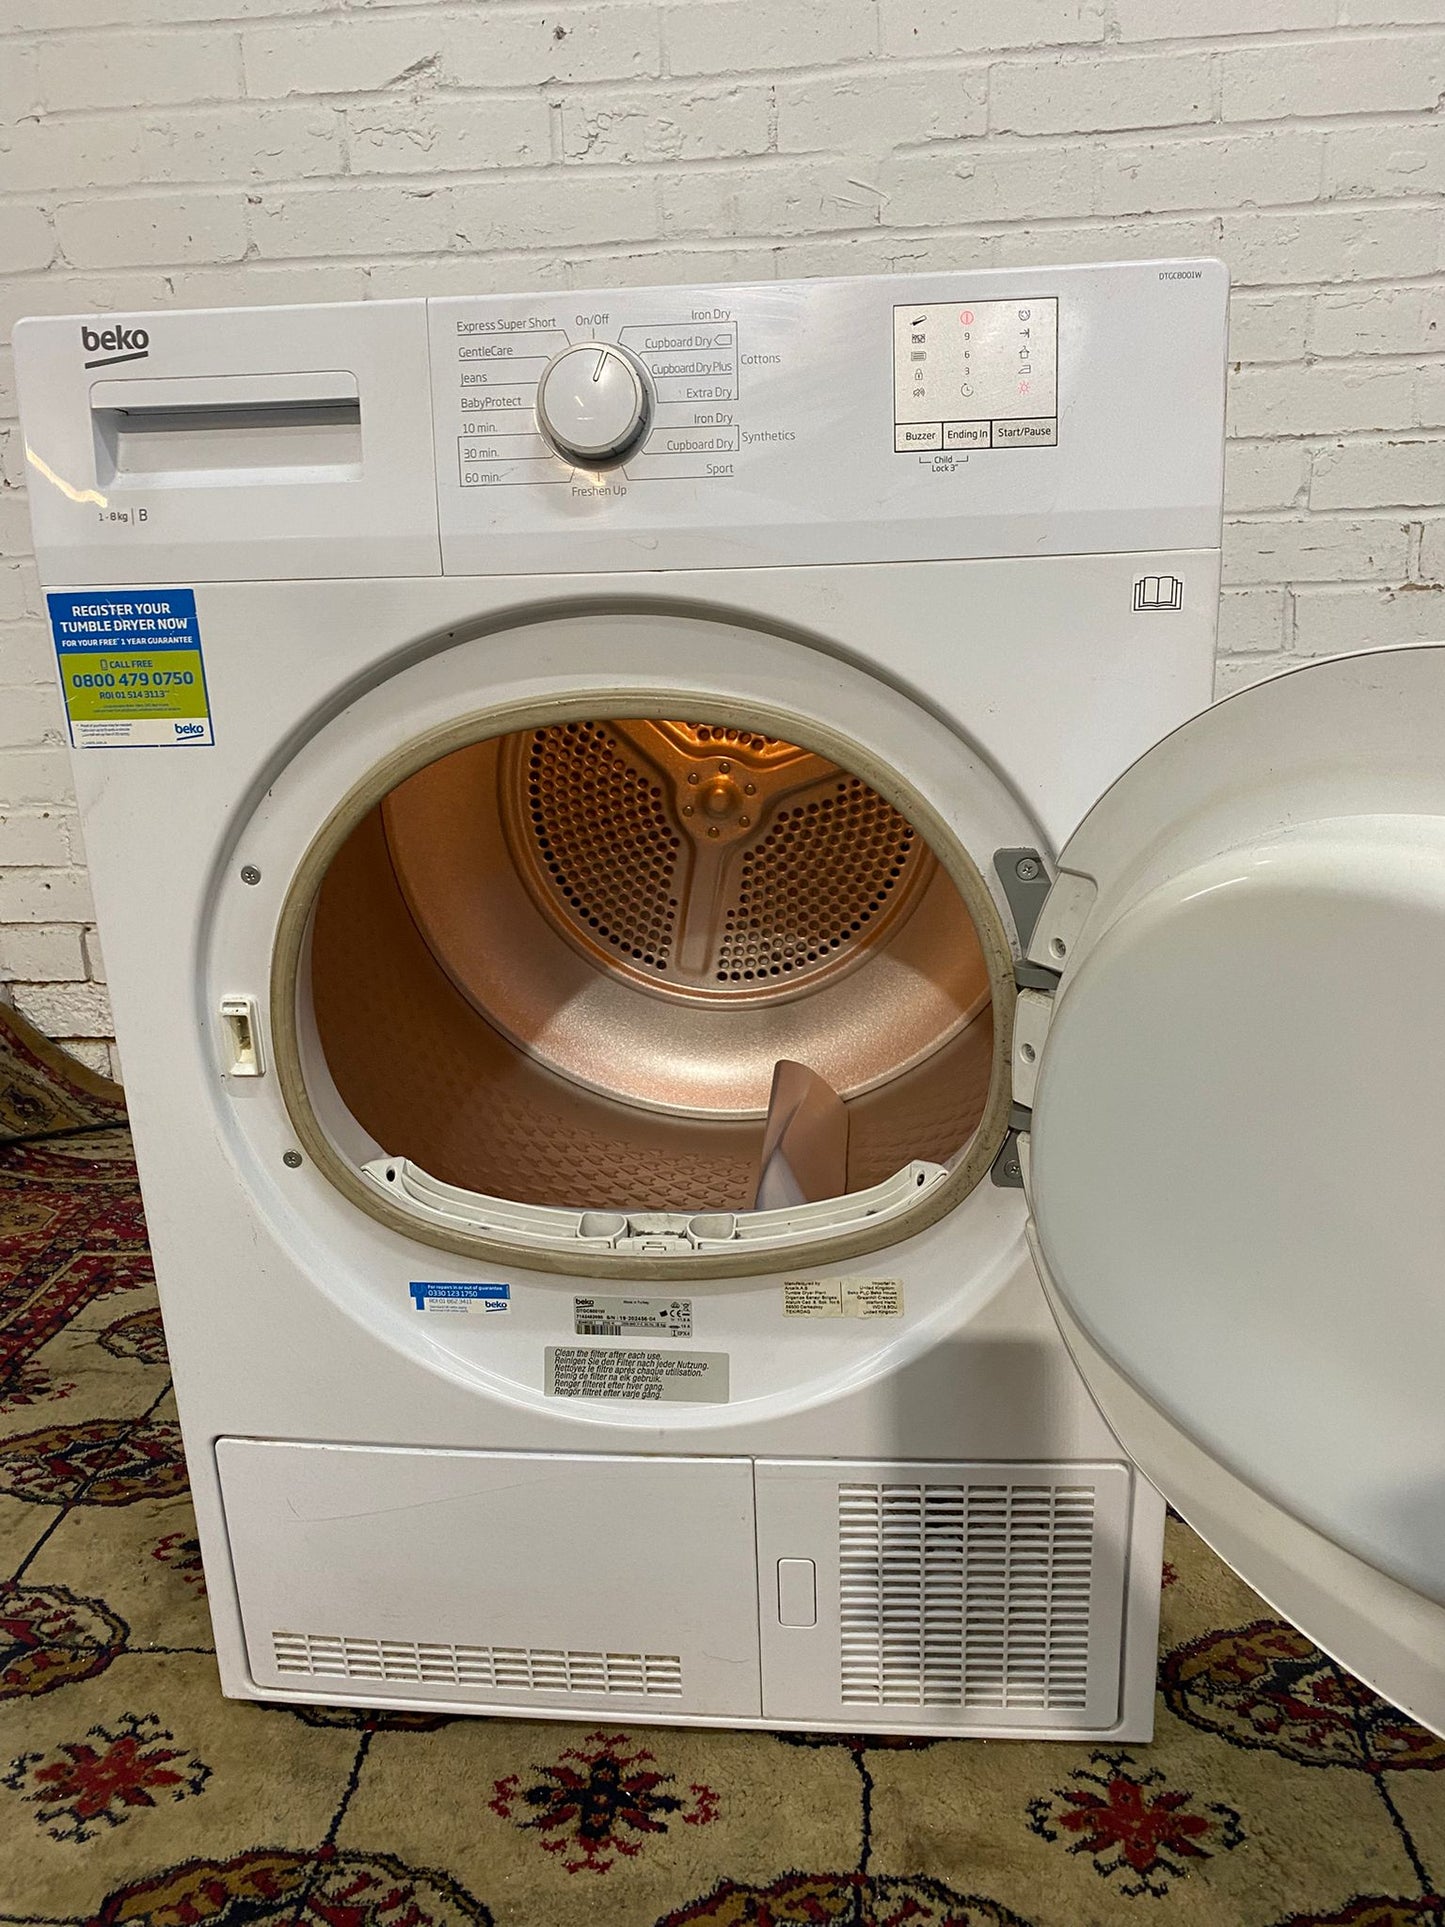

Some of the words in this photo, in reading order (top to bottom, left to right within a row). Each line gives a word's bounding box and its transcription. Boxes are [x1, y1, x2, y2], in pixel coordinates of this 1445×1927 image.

[575, 314, 610, 326] On/Off
[692, 310, 712, 320] Iron
[714, 309, 731, 320] Dry
[456, 321, 496, 332] Express
[498, 320, 526, 330] Super
[529, 318, 556, 328] Short
[82, 324, 150, 352] beko
[964, 332, 970, 340] 9
[645, 337, 692, 350] Cupboard
[695, 336, 712, 348] Dry
[458, 346, 514, 358] GentleCare
[740, 354, 781, 365] Cottons
[652, 364, 694, 376] Cupboard
[696, 363, 712, 374] Dry
[713, 362, 732, 372] Plus
[964, 368, 970, 376] 3
[460, 373, 488, 384] Jeans
[686, 388, 713, 398] Extra
[715, 387, 732, 398] Dry
[461, 396, 522, 410] BabyProtect
[694, 414, 714, 424] Iron
[716, 412, 734, 424] Dry
[463, 423, 475, 433] 10
[478, 422, 498, 433] min.
[998, 427, 1051, 437] Start/Pause
[742, 431, 796, 444] Synthetics
[906, 432, 936, 440] Buzzer
[948, 430, 978, 440] Ending
[979, 430, 988, 438] In
[667, 440, 714, 452] Cupboard
[716, 439, 734, 450] Dry
[464, 449, 477, 458] 30
[479, 448, 499, 458] min.
[935, 456, 953, 464] Child
[706, 464, 734, 475] Sport
[465, 473, 479, 483] 60
[480, 472, 501, 482] min.
[572, 486, 611, 497] Freshen
[613, 485, 627, 496] Up
[139, 509, 148, 521] B
[72, 604, 134, 617] REGISTER
[135, 603, 171, 614] YOUR
[60, 620, 114, 633] TUMBLE
[114, 619, 156, 631] DRYER
[157, 618, 188, 630] NOW
[148, 636, 193, 644] GUARANTEE
[110, 661, 130, 669] CALL
[72, 674, 115, 688] 0800
[119, 673, 148, 686] 479
[152, 672, 193, 685] 0750
[175, 724, 204, 734] beko
[554, 1349, 574, 1357] Clean
[577, 1349, 589, 1358] the
[590, 1350, 607, 1358] filter
[609, 1350, 626, 1359] after
[628, 1351, 645, 1359] each
[554, 1357, 586, 1366] Reinigen
[616, 1359, 635, 1367] Filter
[656, 1360, 676, 1369] jeder
[677, 1361, 709, 1370] Nutzung.
[554, 1365, 587, 1374] Nettoyez
[596, 1366, 614, 1374] filtre
[637, 1367, 664, 1376] chaque
[665, 1368, 703, 1377] utilisation.
[554, 1372, 577, 1382] Reinig
[590, 1373, 607, 1382] filter
[632, 1375, 662, 1383] gebruik.
[582, 1381, 606, 1389] filteret
[607, 1381, 625, 1390] efter
[582, 1388, 602, 1396] filtret
[603, 1389, 620, 1397] efter
[622, 1390, 640, 1399] varje
